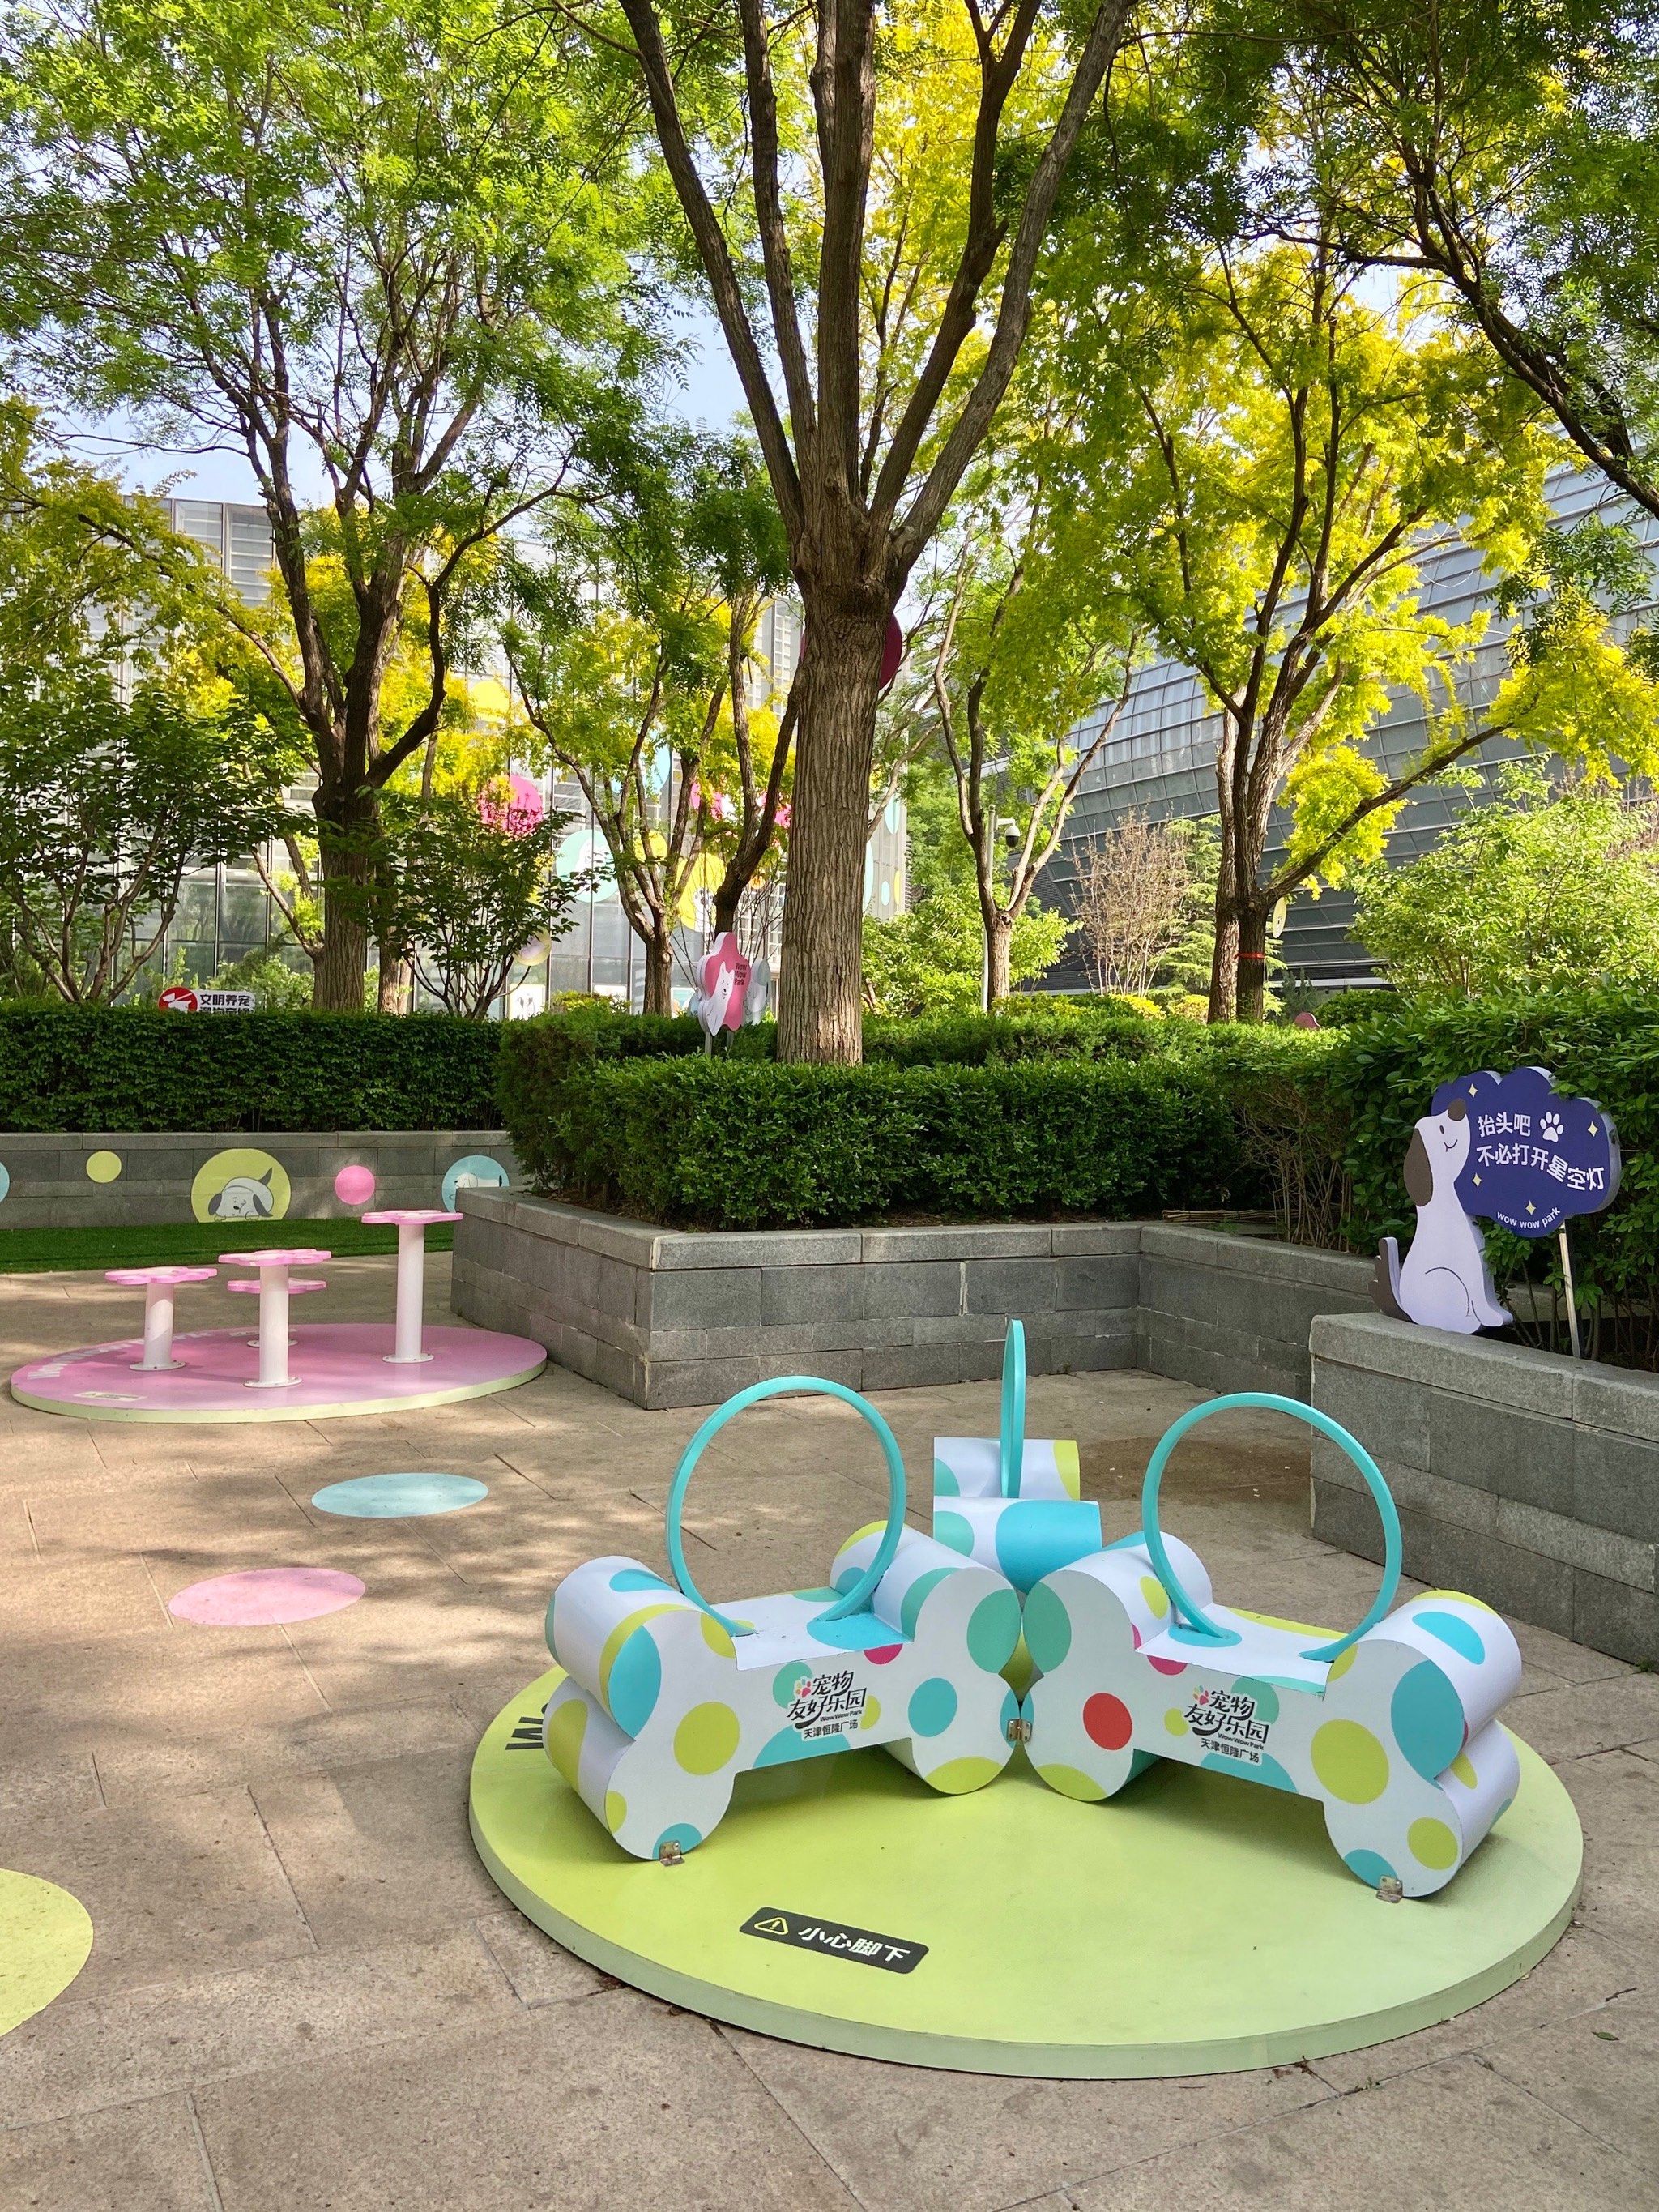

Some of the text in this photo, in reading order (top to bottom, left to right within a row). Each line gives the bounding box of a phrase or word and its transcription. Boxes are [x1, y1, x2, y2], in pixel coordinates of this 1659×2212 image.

[200, 994, 250, 1006] 文明养宠
[1477, 1112, 1531, 1138] 抬头吧
[1476, 1142, 1605, 1191] 不必打开星空灯
[1497, 1206, 1561, 1229] wow wow park
[811, 1670, 854, 1697] 宠物
[787, 1687, 867, 1729] 友好乐园
[1209, 1689, 1255, 1721] 宠物
[804, 1719, 859, 1740] 天津恒隆广场
[1184, 1703, 1269, 1744] 友好乐园
[1201, 1737, 1260, 1763] 天津恒隆广场
[798, 1927, 911, 1962] 小心脚下
